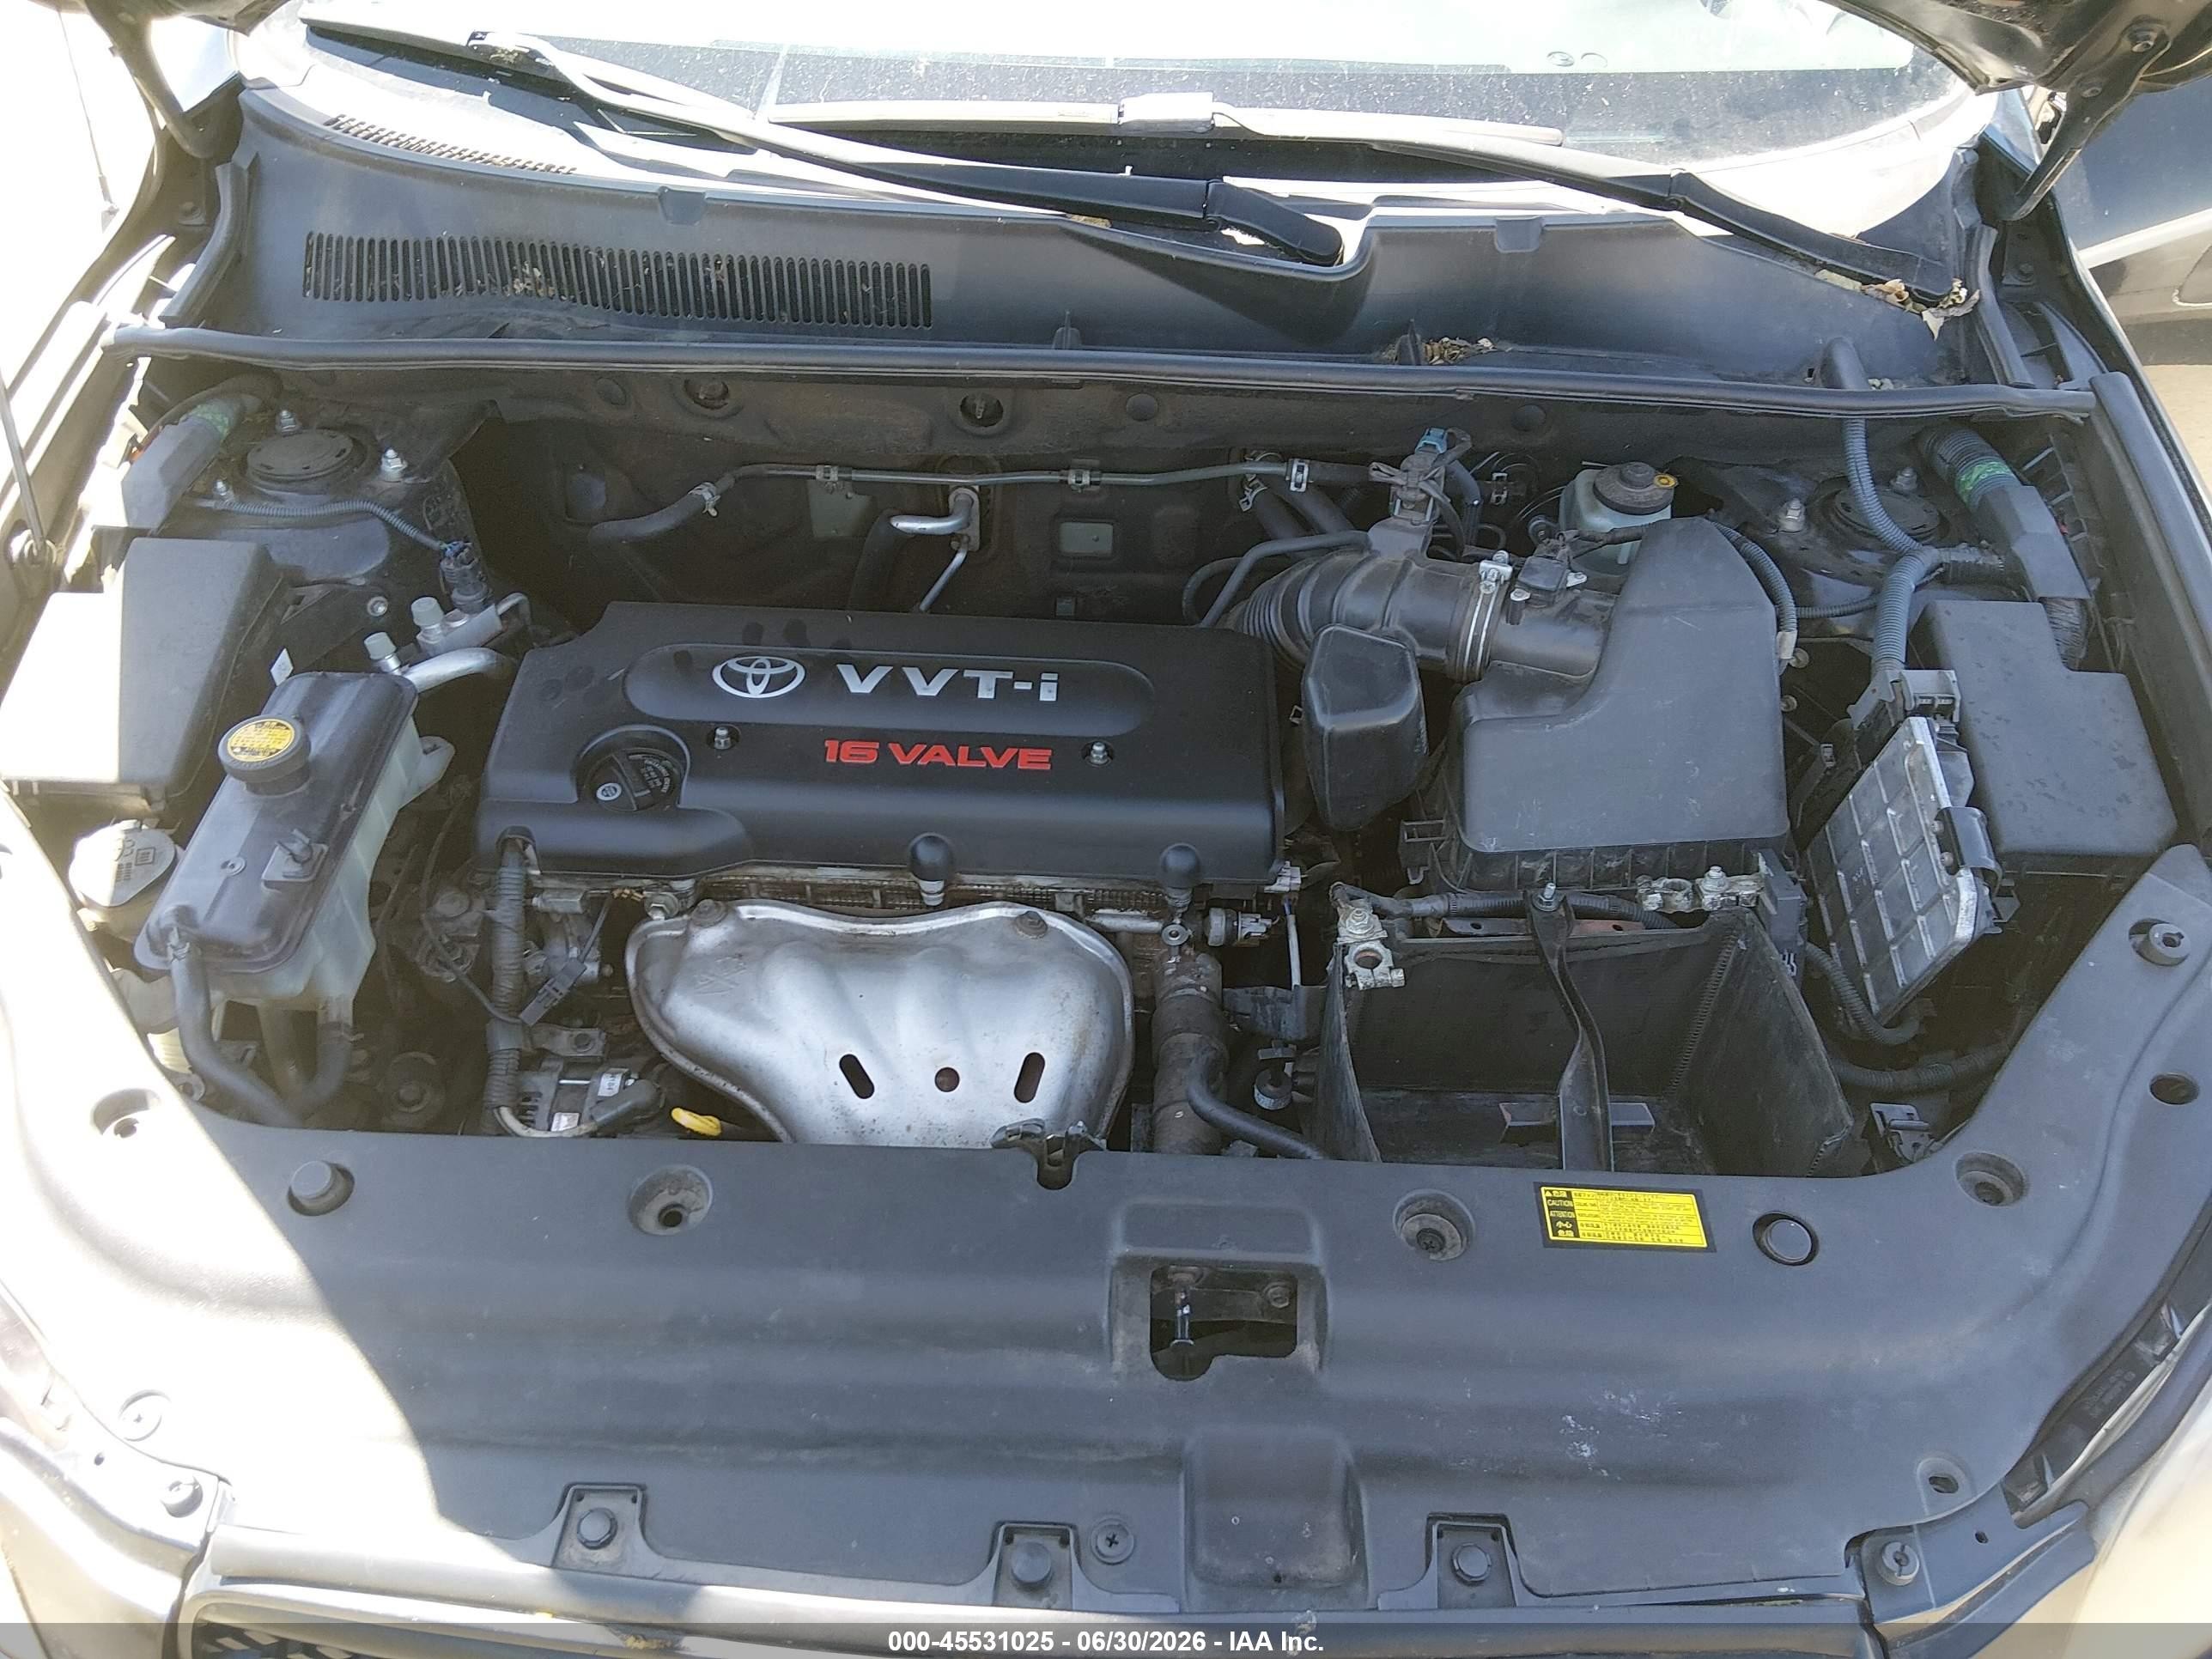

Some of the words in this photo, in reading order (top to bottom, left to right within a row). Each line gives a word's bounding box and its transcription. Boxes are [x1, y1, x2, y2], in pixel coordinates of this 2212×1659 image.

[836, 663, 1059, 702] VVT-i
[824, 739, 880, 763] 16
[887, 742, 1053, 770] VALVE
[1547, 1199, 1574, 1207] CAUTION
